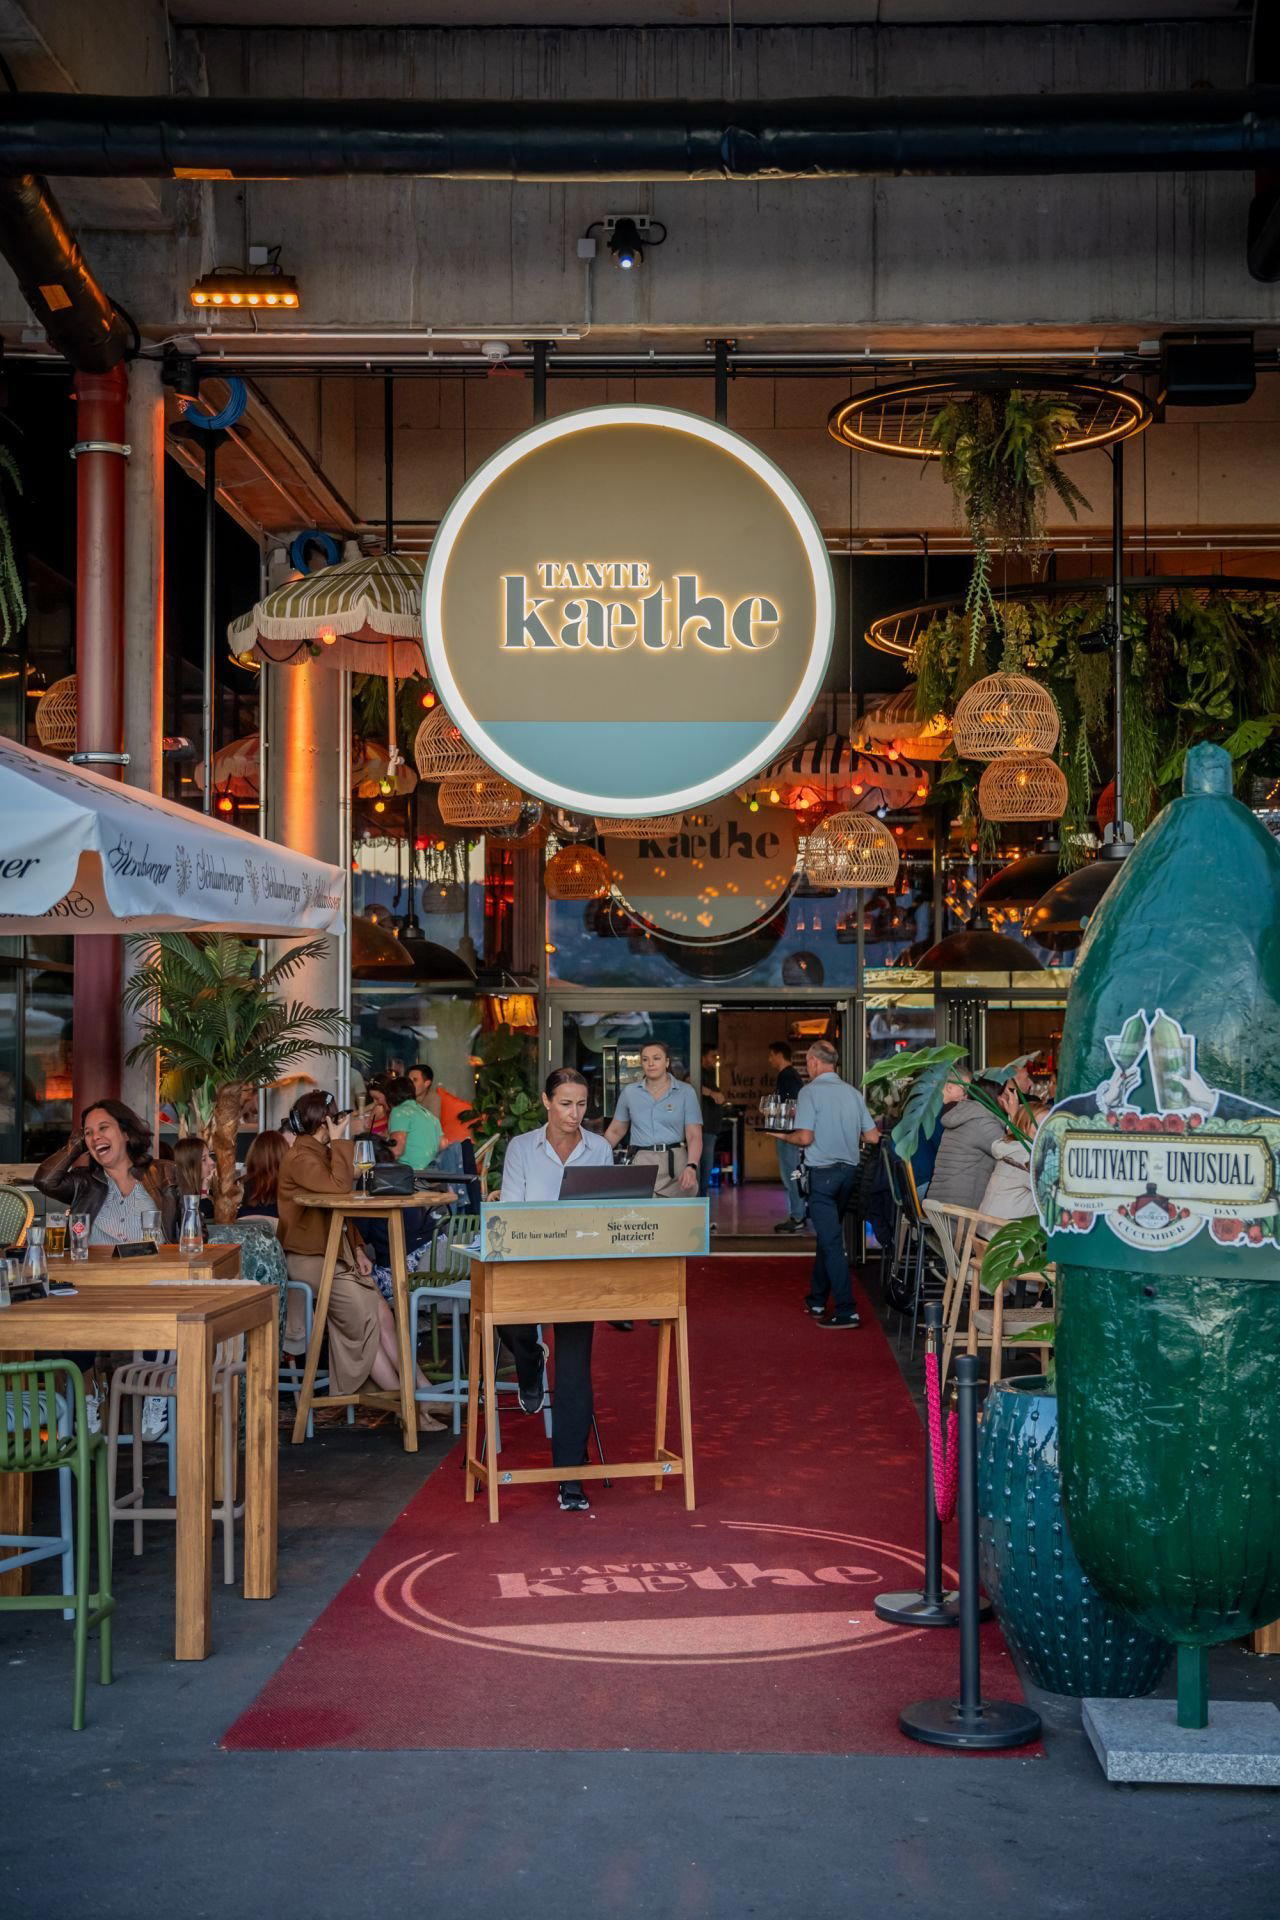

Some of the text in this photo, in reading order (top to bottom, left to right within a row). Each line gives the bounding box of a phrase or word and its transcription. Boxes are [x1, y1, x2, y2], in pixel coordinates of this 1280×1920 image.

[537, 562, 650, 588] TANTE
[499, 574, 780, 650] kaethe
[1067, 1147, 1148, 1181] CULTIVATE
[1166, 1150, 1255, 1185] UNUSUAL
[607, 1221, 659, 1231] Sie werden
[1073, 1201, 1240, 1241] WORLD CUCUMBER DAY
[511, 1230, 528, 1240] Bitte
[543, 1229, 568, 1240] warten!
[611, 1231, 655, 1243] platziert!
[539, 1561, 694, 1578] TANTE
